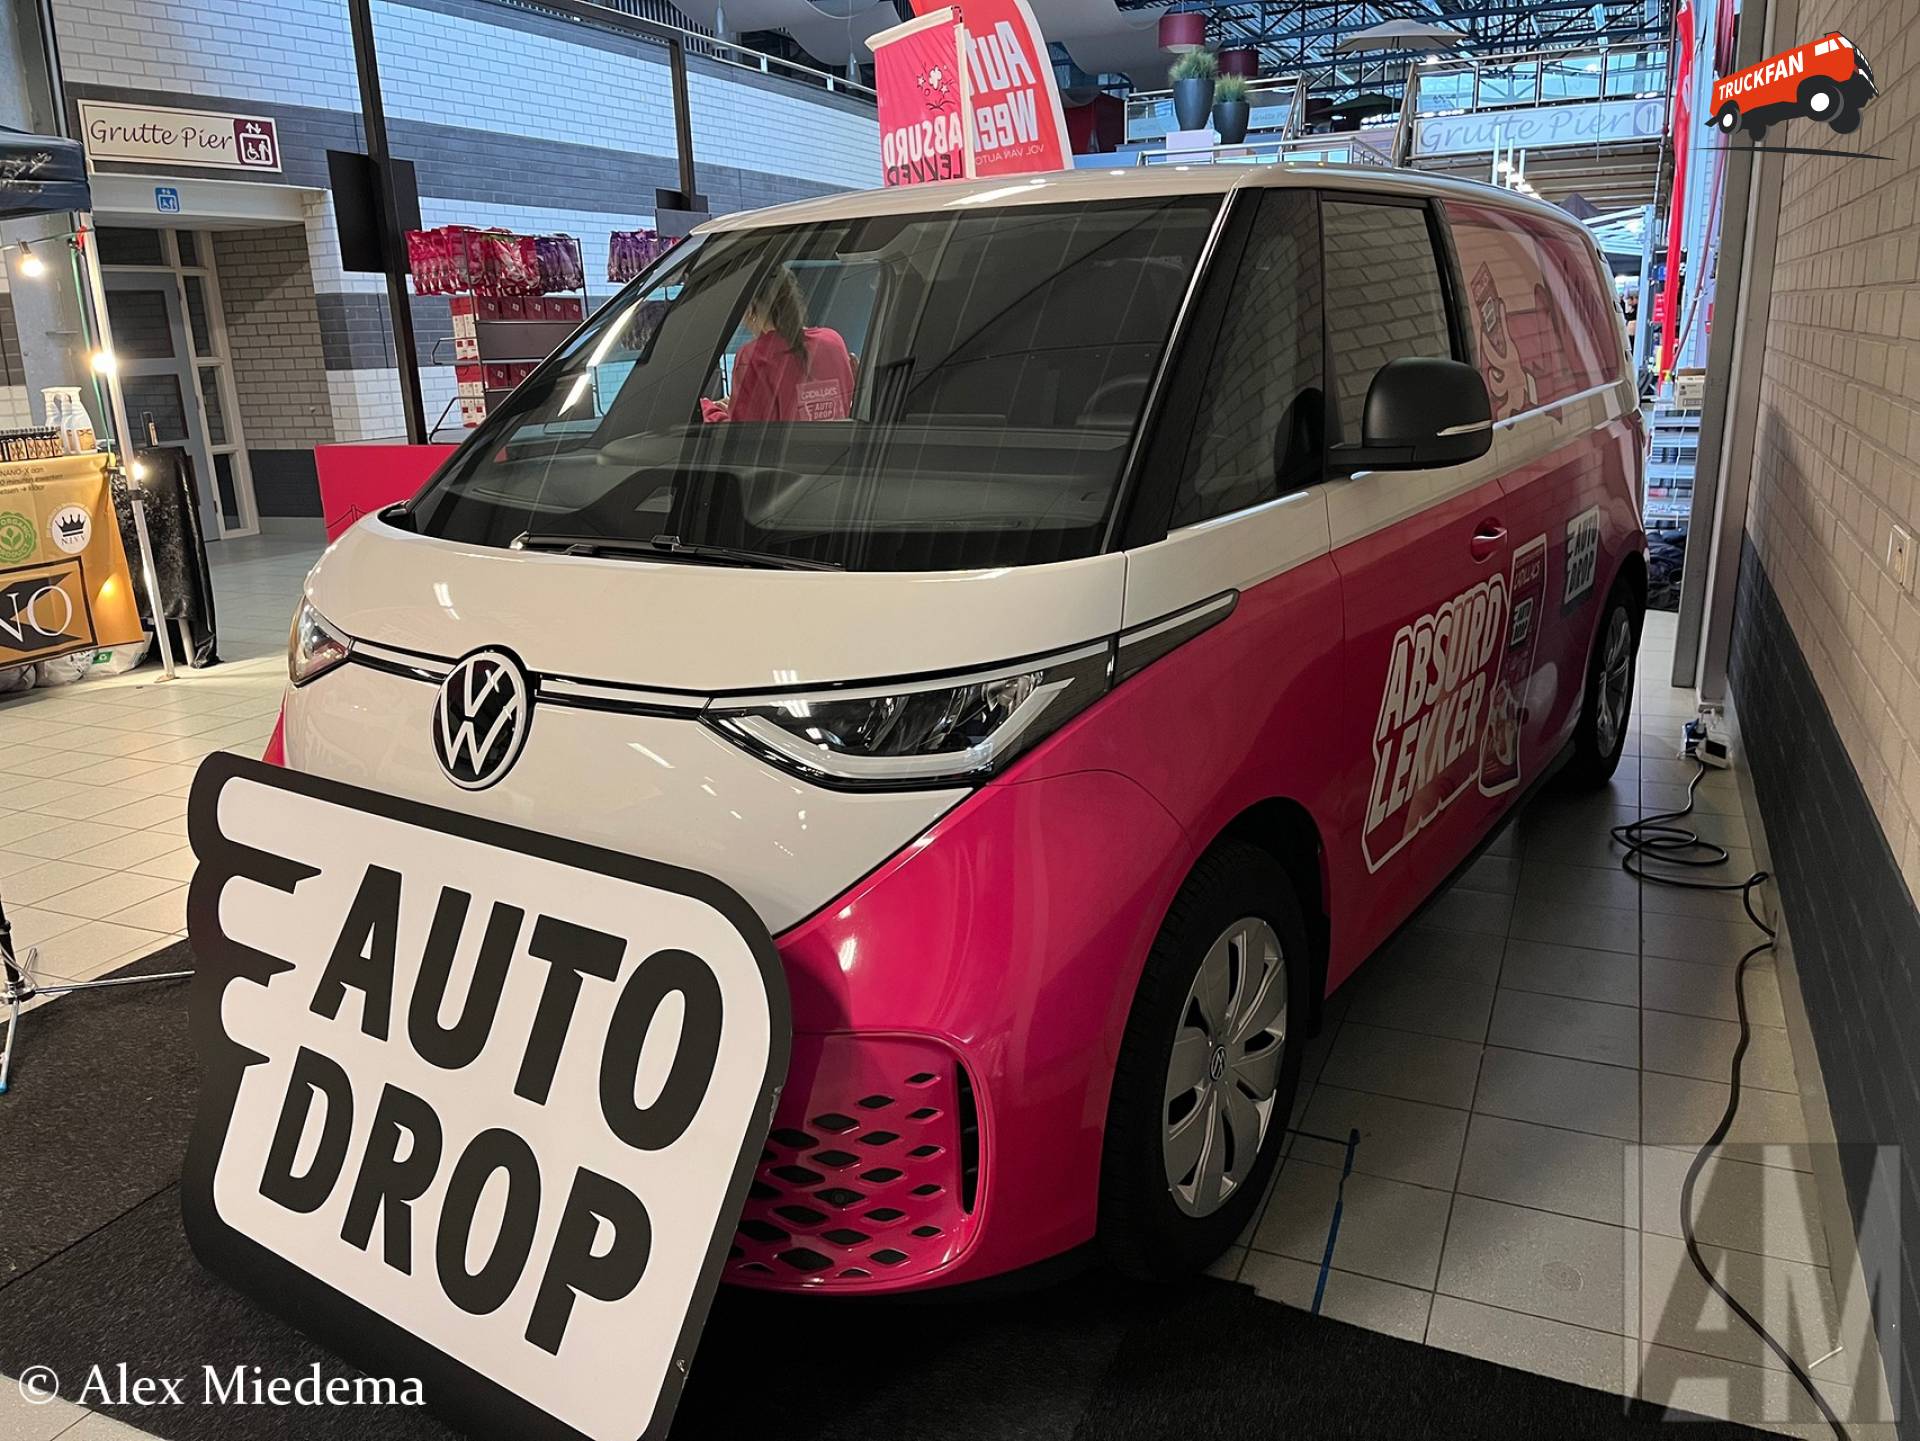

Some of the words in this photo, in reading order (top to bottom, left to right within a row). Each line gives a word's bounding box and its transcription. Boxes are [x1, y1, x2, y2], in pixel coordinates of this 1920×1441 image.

[90, 119, 178, 145] Grutte
[181, 126, 233, 150] Pier
[1420, 115, 1543, 151] Grutte
[1545, 110, 1634, 139] Pier
[1568, 551, 1596, 595] DROP
[1575, 512, 1598, 557] AUTO
[437, 657, 521, 780] VW
[1379, 583, 1500, 742] ABSURD
[1366, 671, 1486, 834] LEKKER
[309, 864, 724, 1151] AUTO
[259, 1045, 653, 1356] DROP
